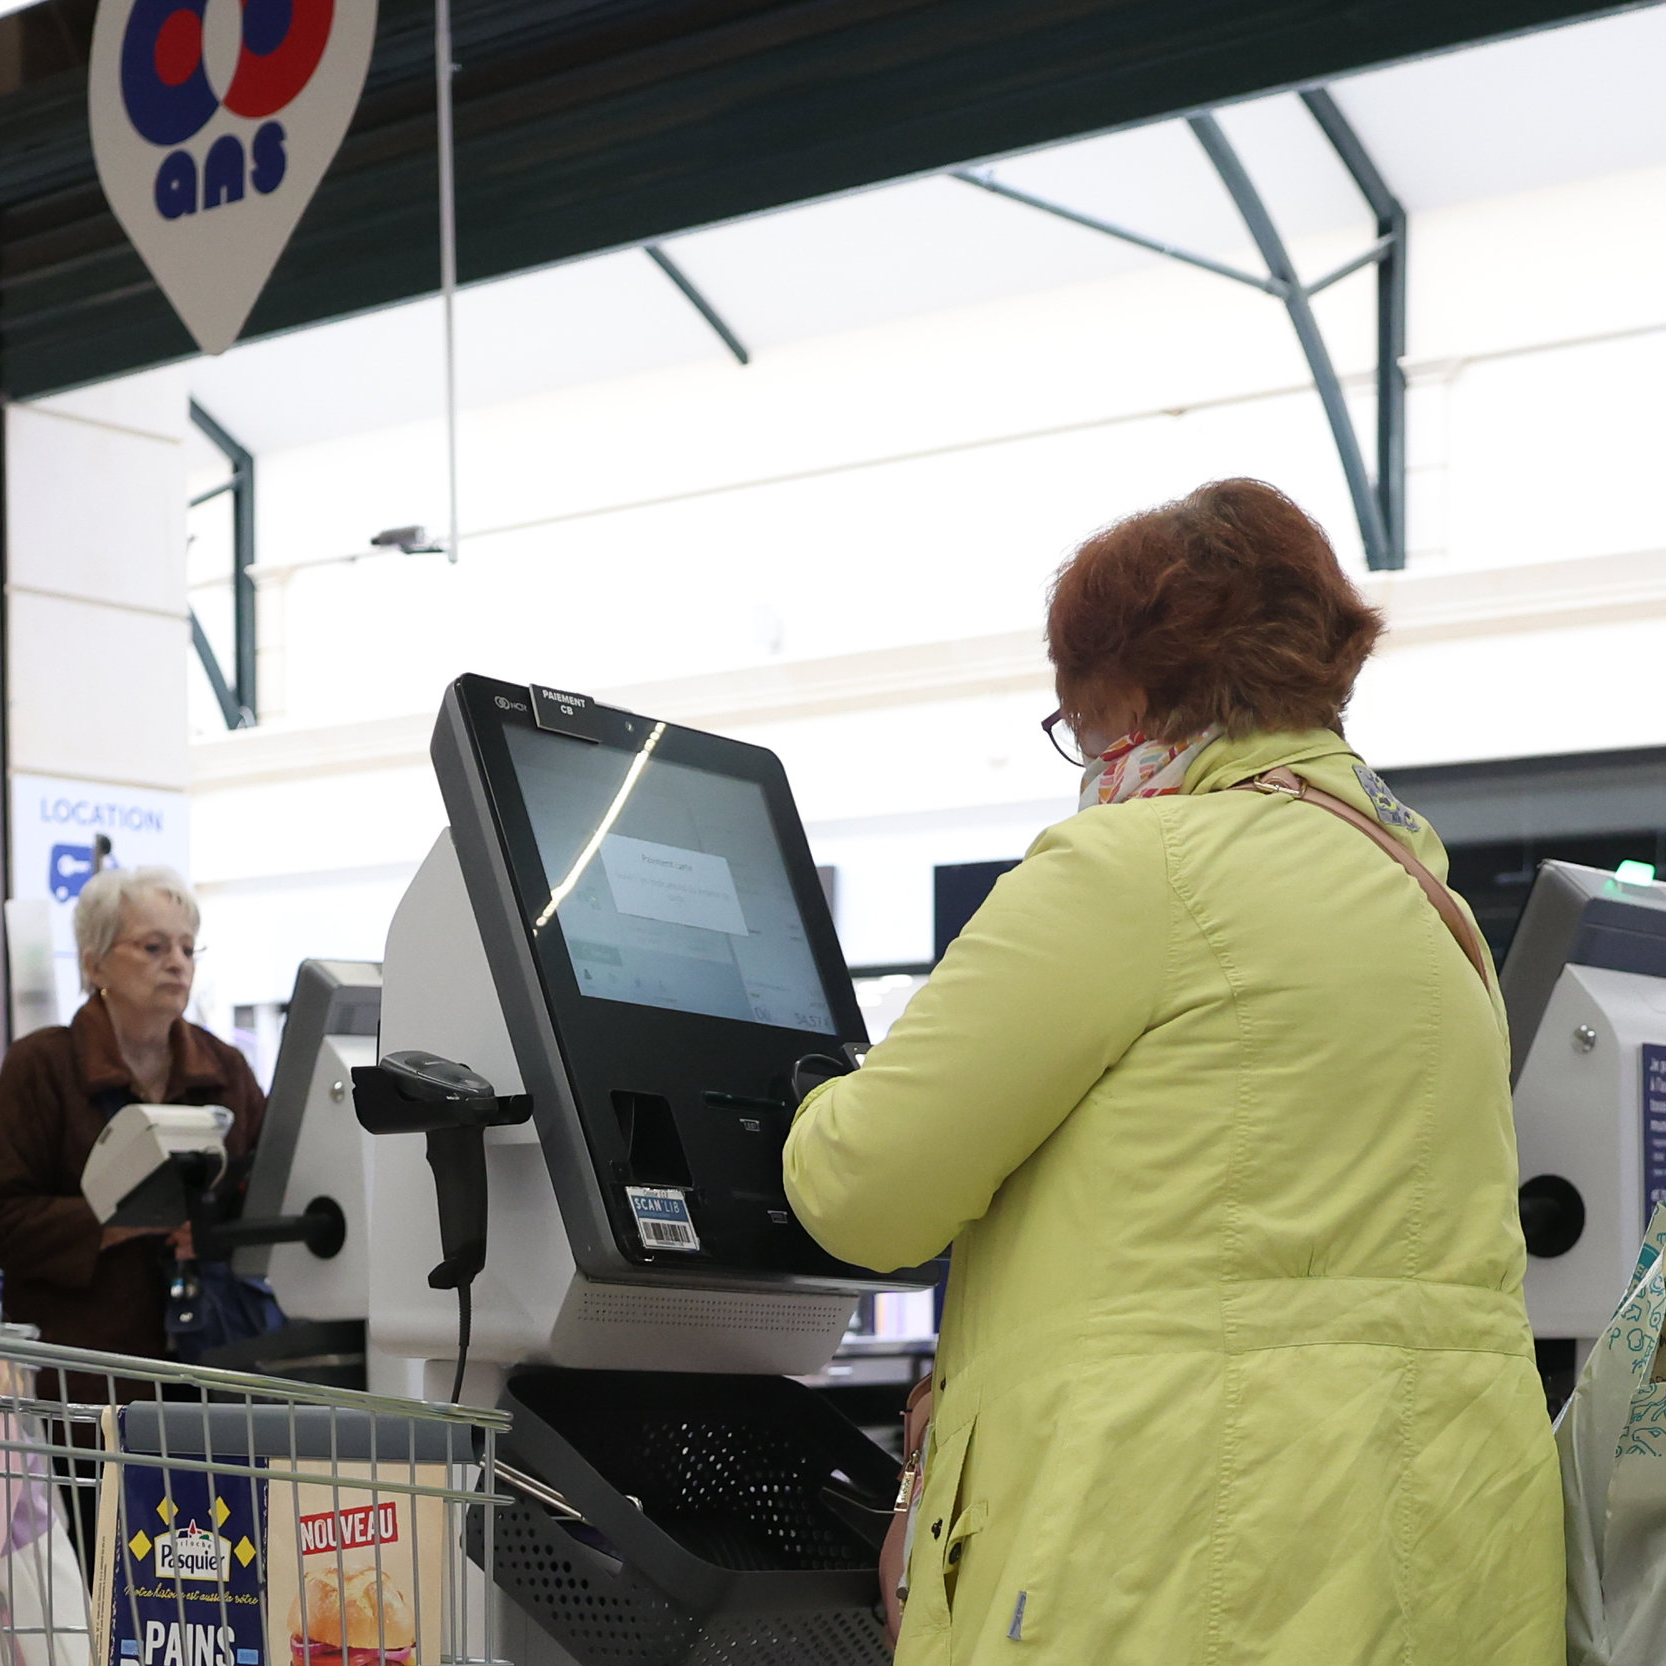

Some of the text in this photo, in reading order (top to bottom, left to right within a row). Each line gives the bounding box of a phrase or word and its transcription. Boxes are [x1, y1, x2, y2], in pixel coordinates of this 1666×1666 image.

[154, 121, 287, 220] ans
[542, 689, 586, 708] PAIEMENT
[560, 705, 573, 716] CB
[40, 798, 164, 832] LOCATION
[300, 1508, 393, 1551] NOUVEAU
[161, 1544, 225, 1574] Pasquier
